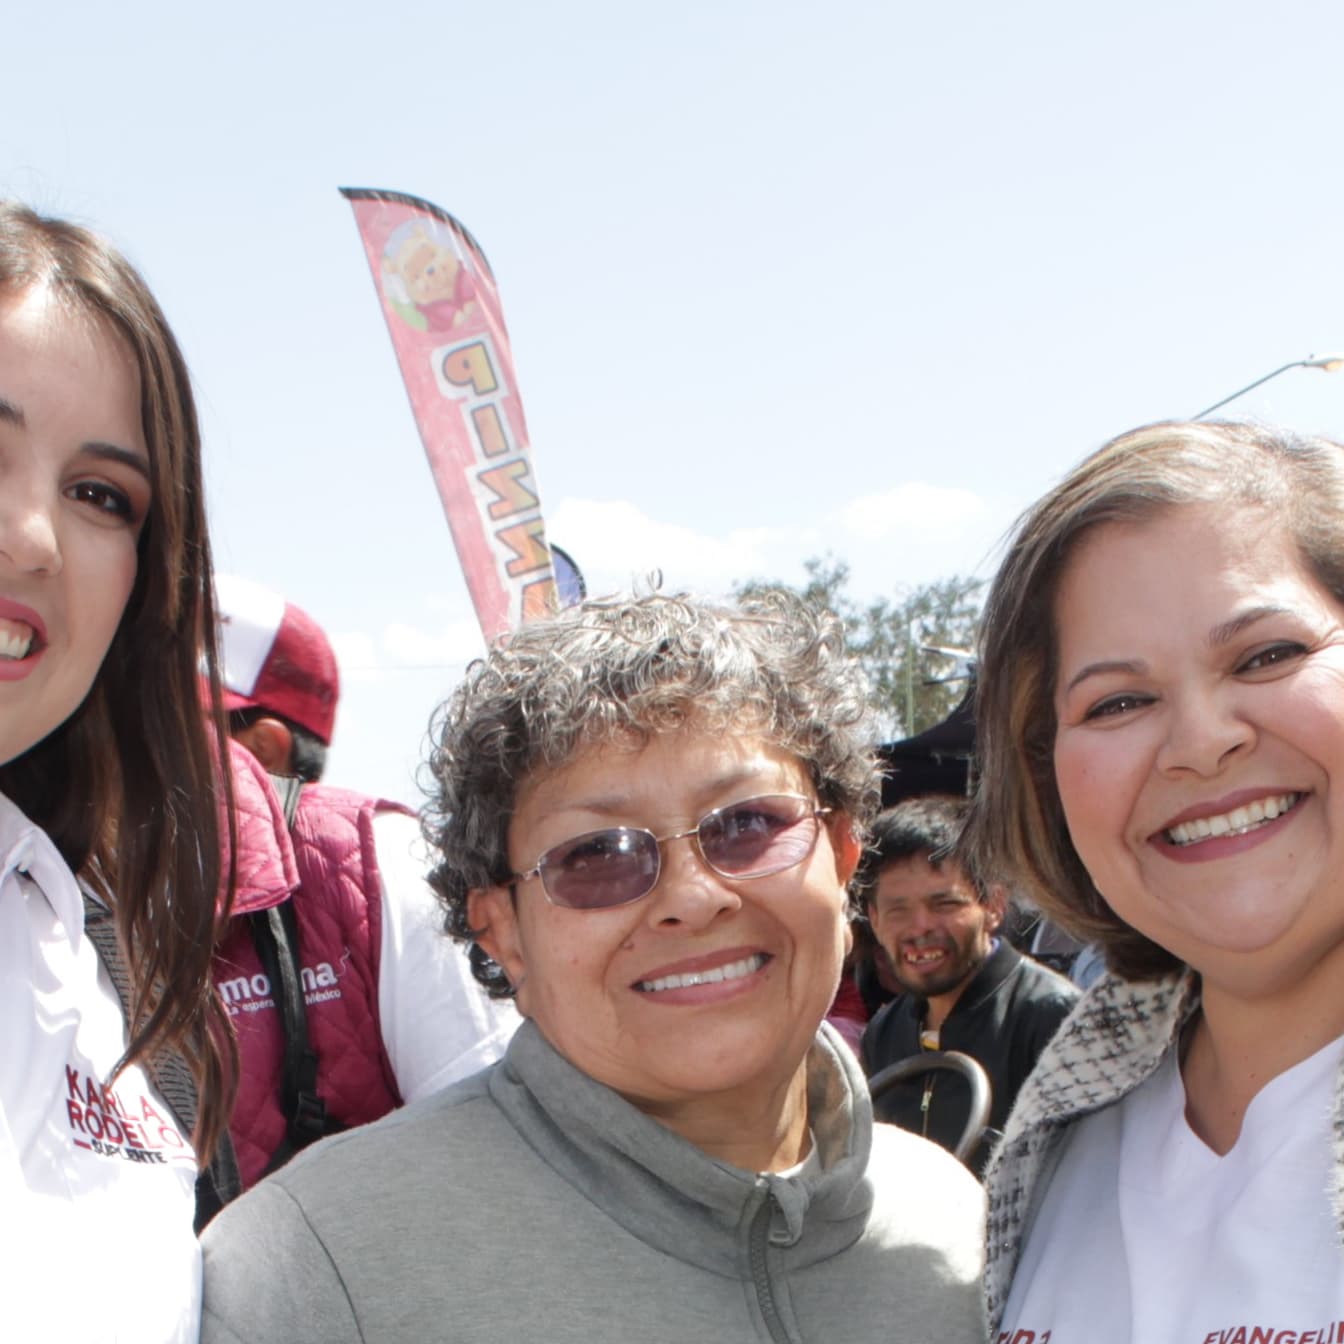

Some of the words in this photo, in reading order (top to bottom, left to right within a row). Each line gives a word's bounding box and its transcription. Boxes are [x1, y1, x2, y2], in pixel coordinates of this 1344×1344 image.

[218, 962, 338, 1005] mona
[65, 1063, 165, 1126] KARLA
[65, 1098, 184, 1150] RODELO
